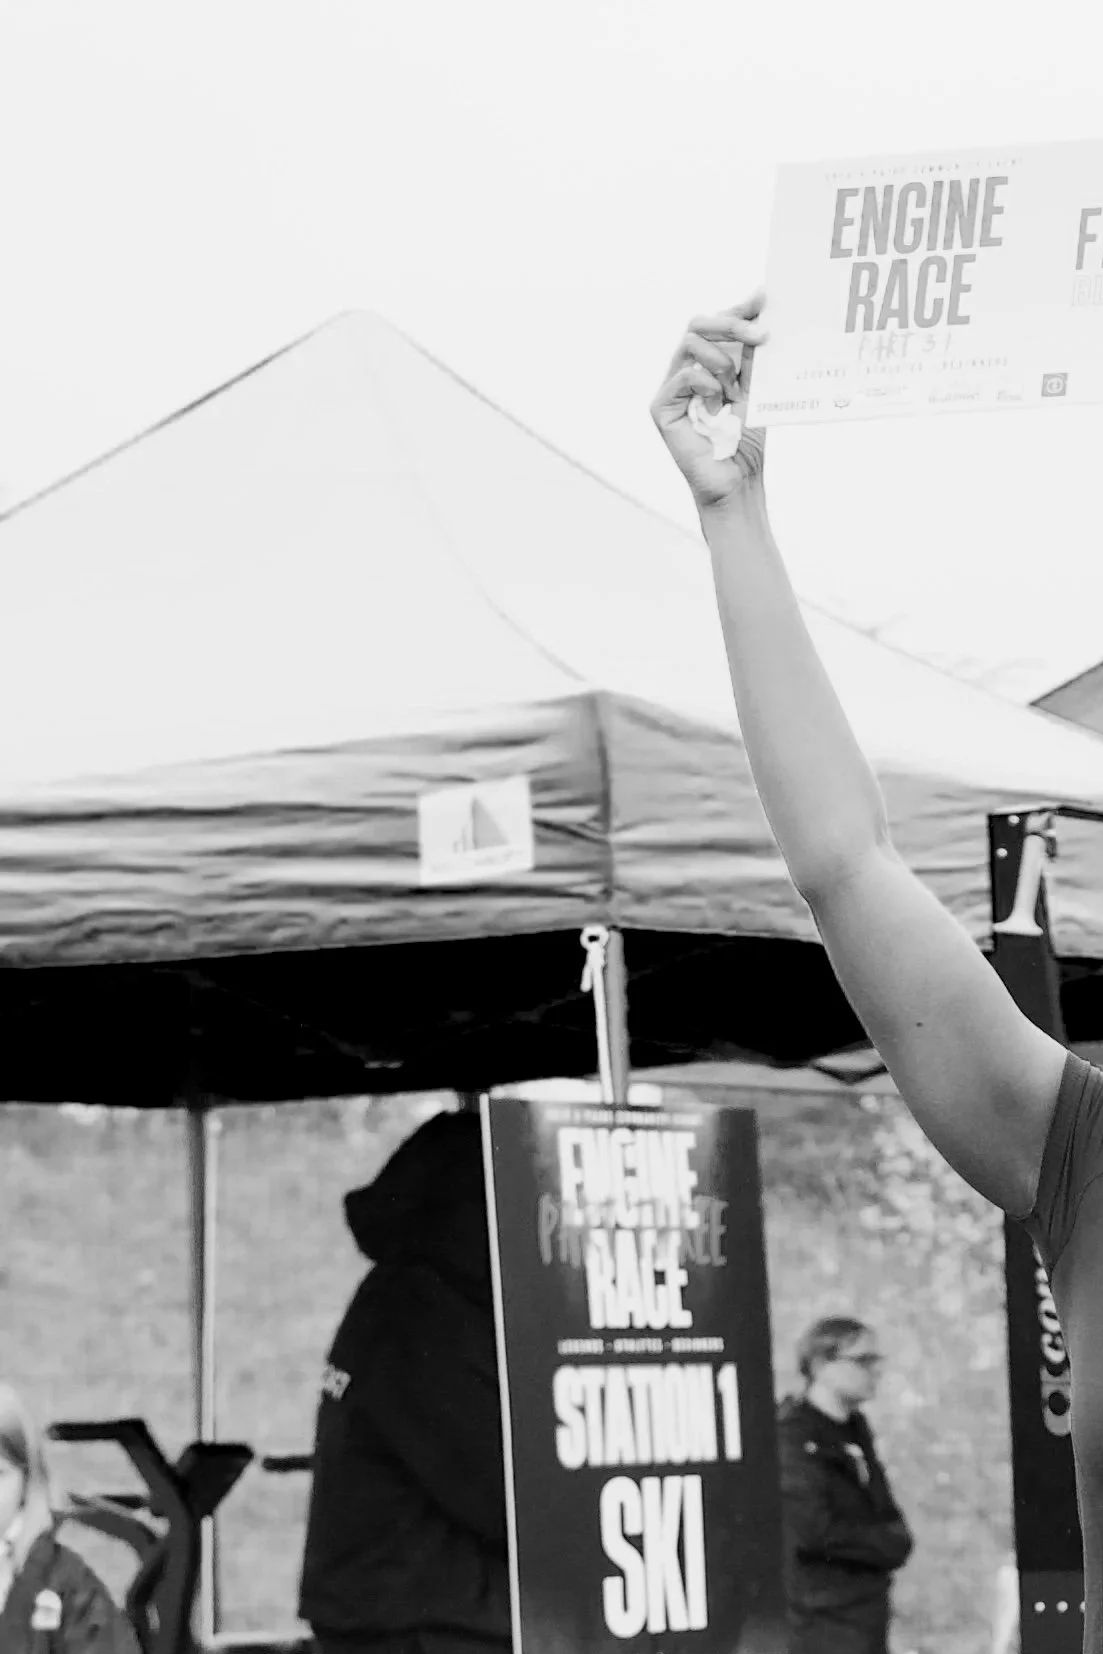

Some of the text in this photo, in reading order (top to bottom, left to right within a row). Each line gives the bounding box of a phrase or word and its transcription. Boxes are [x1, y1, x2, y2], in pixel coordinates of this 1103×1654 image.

[829, 175, 1009, 259] ENGINE
[844, 254, 977, 334] RACE
[558, 1127, 701, 1229] ENGINE
[586, 1227, 694, 1330] RACE
[552, 1361, 742, 1469] STATION 1
[599, 1474, 709, 1639] SKI
